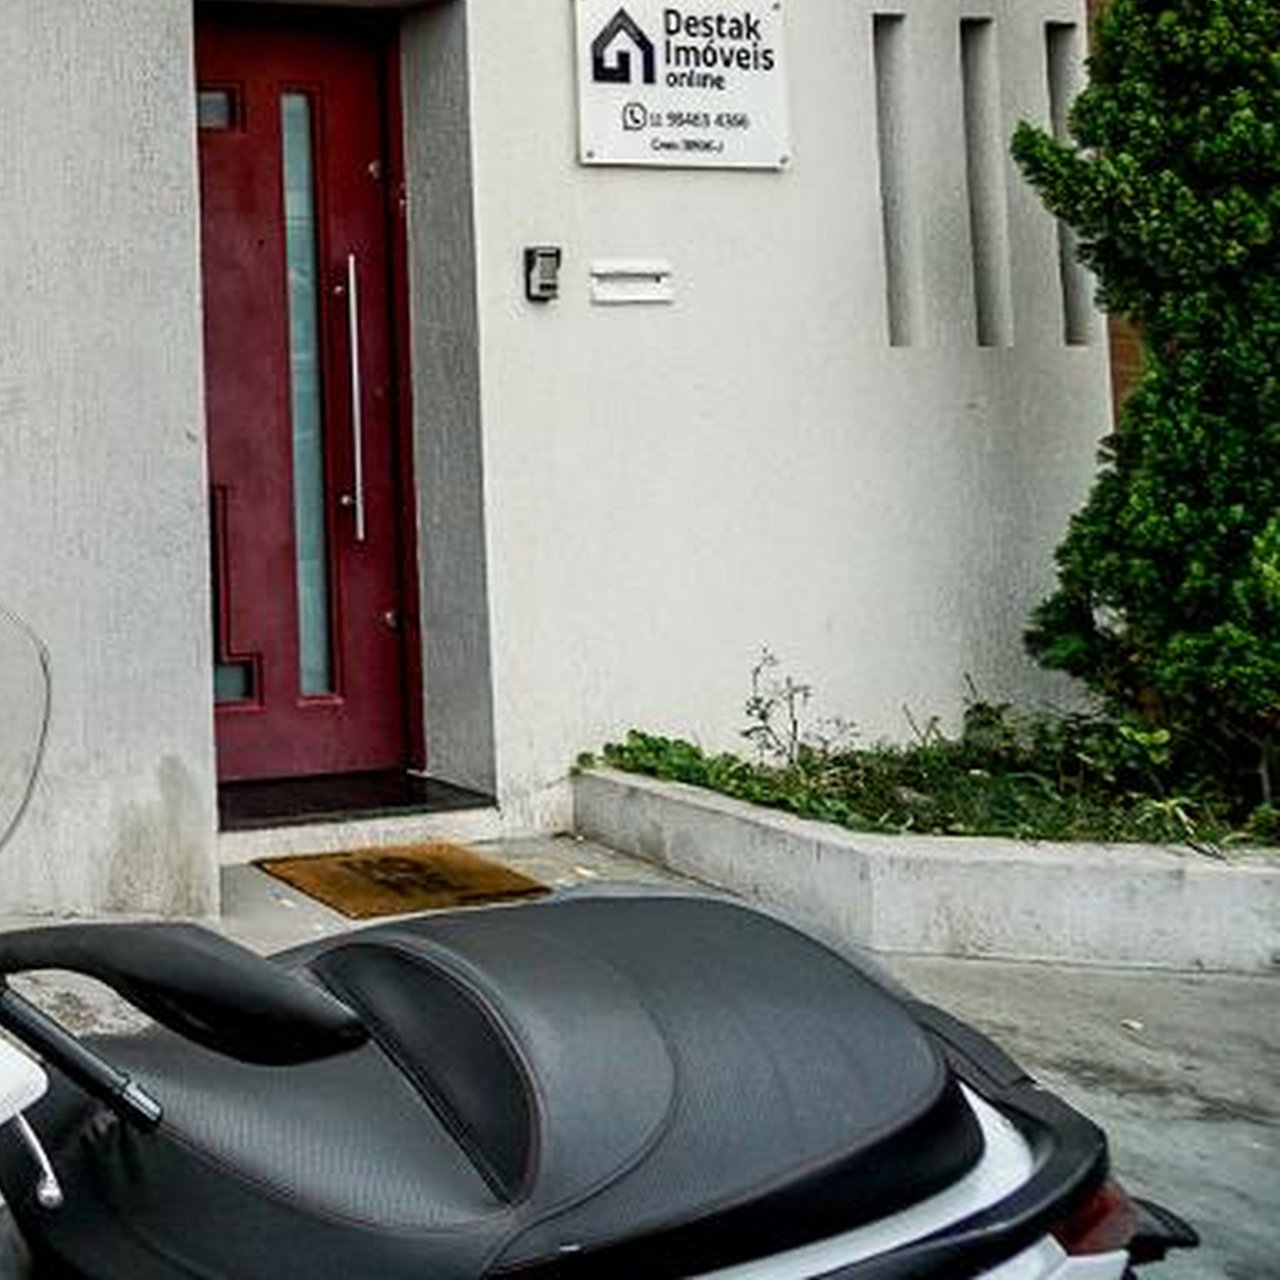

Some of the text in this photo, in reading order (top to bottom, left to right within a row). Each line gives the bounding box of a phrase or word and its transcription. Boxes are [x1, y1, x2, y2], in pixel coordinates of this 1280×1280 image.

[664, 8, 762, 40] Destak
[664, 39, 775, 71] Imóveis
[665, 70, 726, 89] online
